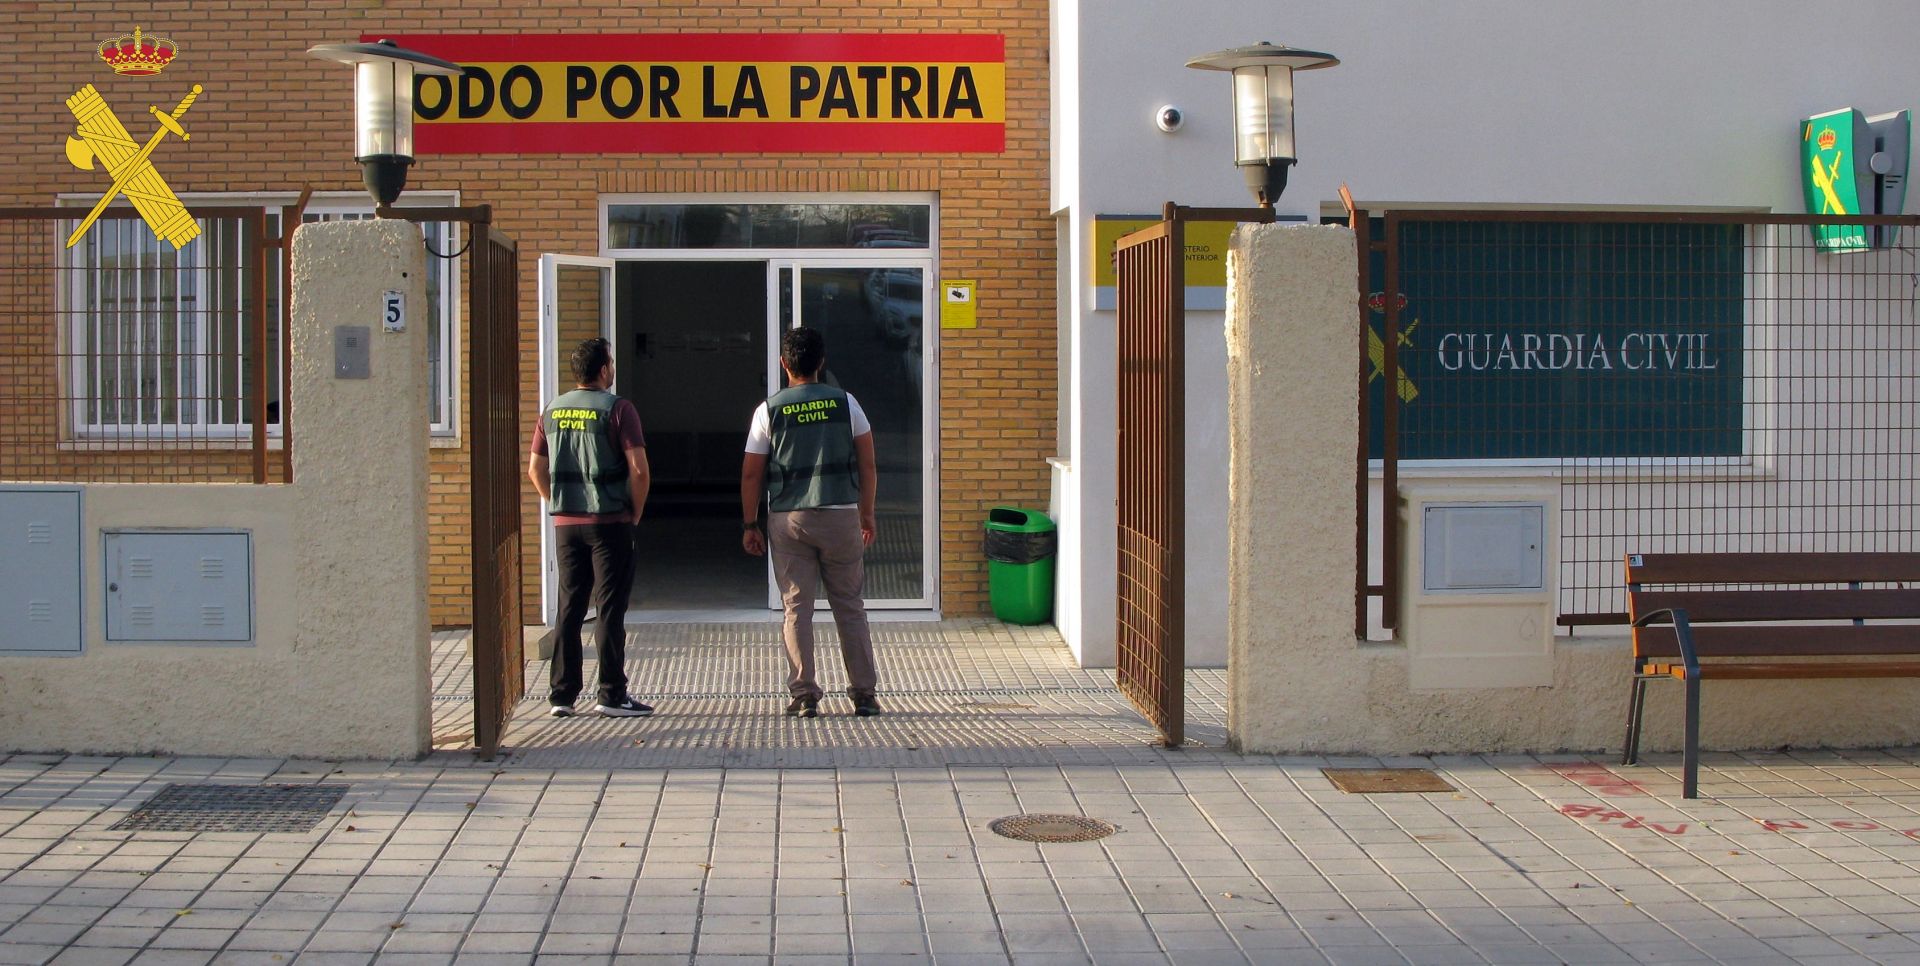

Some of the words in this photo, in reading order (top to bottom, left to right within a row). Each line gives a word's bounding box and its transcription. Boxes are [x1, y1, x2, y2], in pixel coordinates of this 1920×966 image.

[413, 64, 543, 120] ODO
[566, 64, 681, 119] POR
[702, 65, 769, 118] LA
[790, 65, 983, 118] PATRIA
[387, 298, 400, 322] 5
[1438, 333, 1613, 370] GUARDIA
[1621, 333, 1719, 369] CIVIL
[551, 409, 597, 420] GUARDIA
[782, 400, 837, 415] GUARDIA
[797, 411, 829, 423] CIVIL
[559, 420, 586, 430] CIVIL
